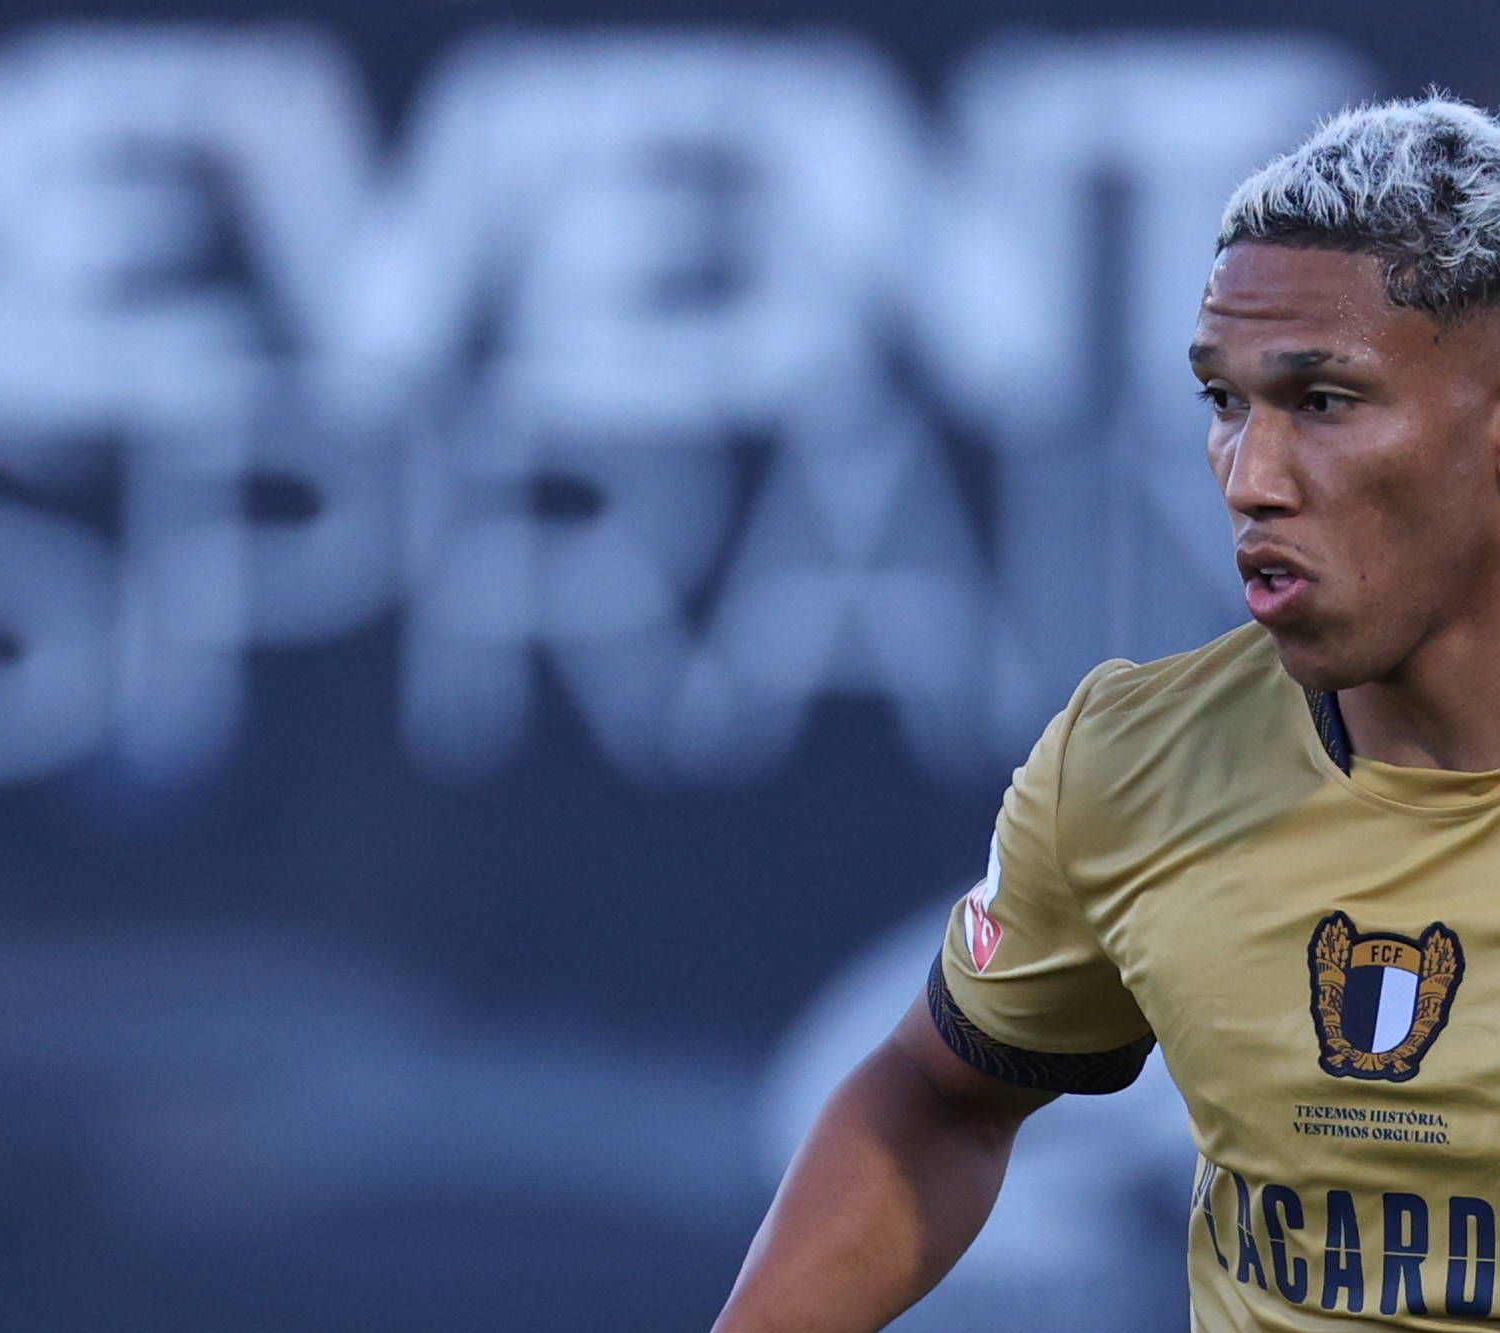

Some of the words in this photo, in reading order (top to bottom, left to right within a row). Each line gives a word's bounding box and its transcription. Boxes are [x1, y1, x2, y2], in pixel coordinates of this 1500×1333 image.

[1371, 943, 1404, 966] FCF
[1294, 1104, 1367, 1122] TECEMOS
[1293, 1121, 1369, 1139] VESTIMOS
[1371, 1127, 1451, 1146] ORGULHO.
